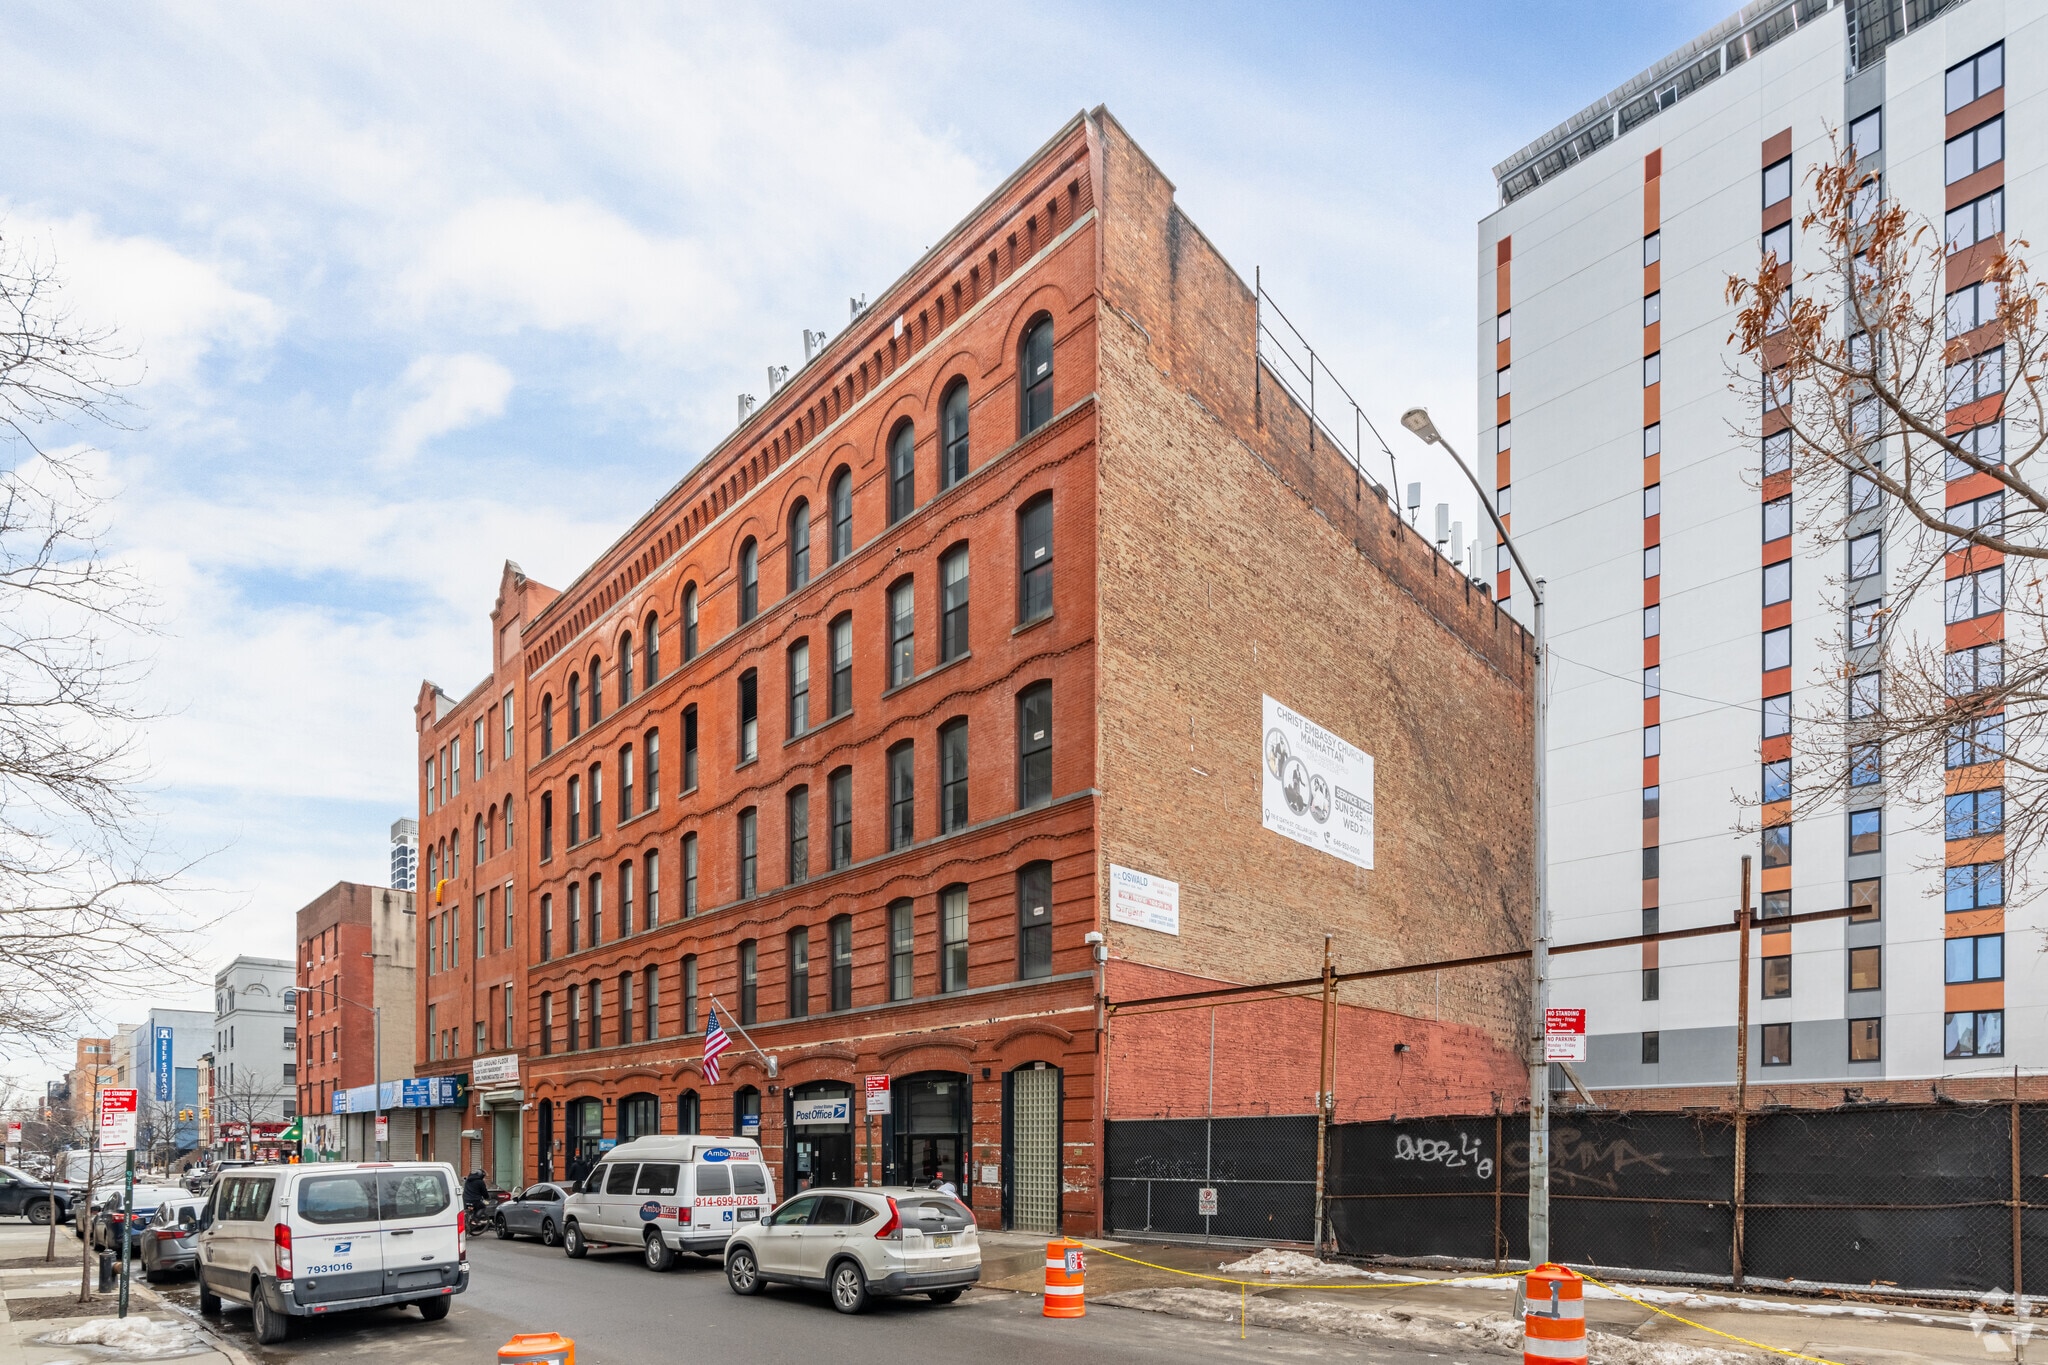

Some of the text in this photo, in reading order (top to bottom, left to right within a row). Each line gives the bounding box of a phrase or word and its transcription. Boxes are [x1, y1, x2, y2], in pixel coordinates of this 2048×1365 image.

[1276, 706, 1303, 729] CHRIST
[1304, 722, 1337, 747] EMBASSY
[1338, 741, 1364, 764] CHURCH
[1300, 732, 1344, 764] MANHATTAN
[1335, 800, 1349, 816] SUN
[1343, 817, 1359, 833] WED
[1122, 871, 1148, 887] OSWALD
[160, 1062, 168, 1099] STORAGE
[796, 1109, 832, 1120] Post Office
[731, 1150, 750, 1158] Trans
[661, 1204, 678, 1214] Trans
[695, 1196, 758, 1207] 914-699-0785
[307, 1262, 353, 1275] 7931016
